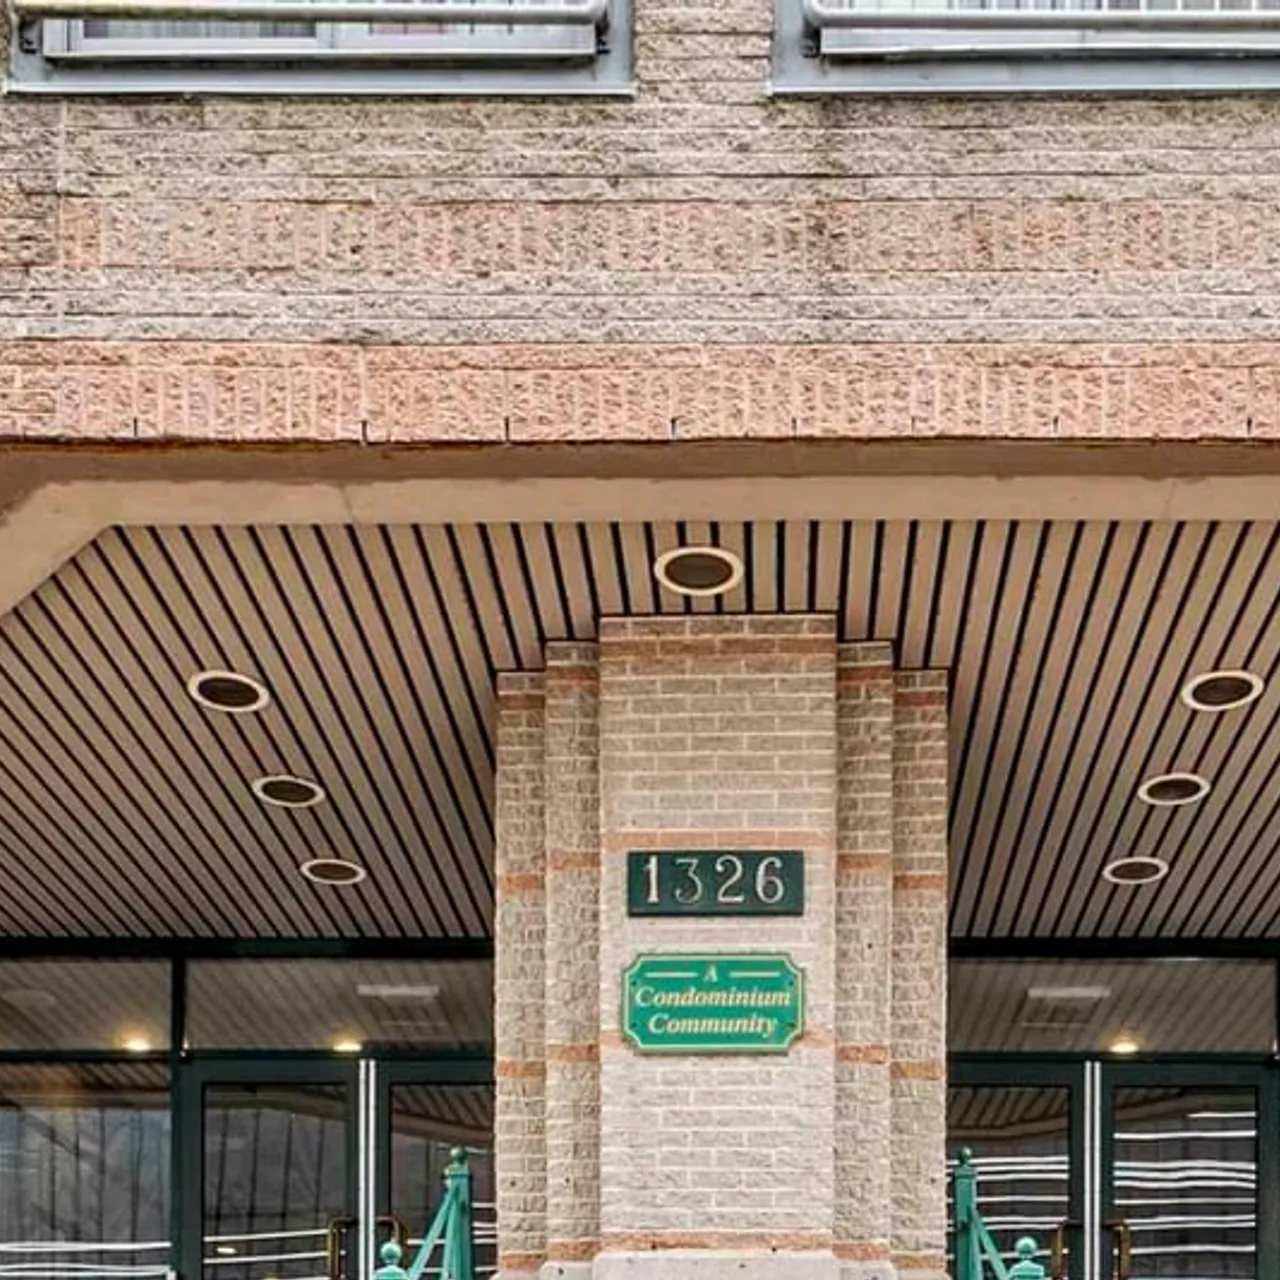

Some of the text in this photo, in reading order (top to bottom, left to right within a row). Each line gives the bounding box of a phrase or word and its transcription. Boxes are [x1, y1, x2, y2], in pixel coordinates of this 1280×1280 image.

[642, 854, 786, 904] 1326
[703, 964, 719, 983] A
[635, 985, 791, 1008] Condominium
[648, 1012, 778, 1039] Community
